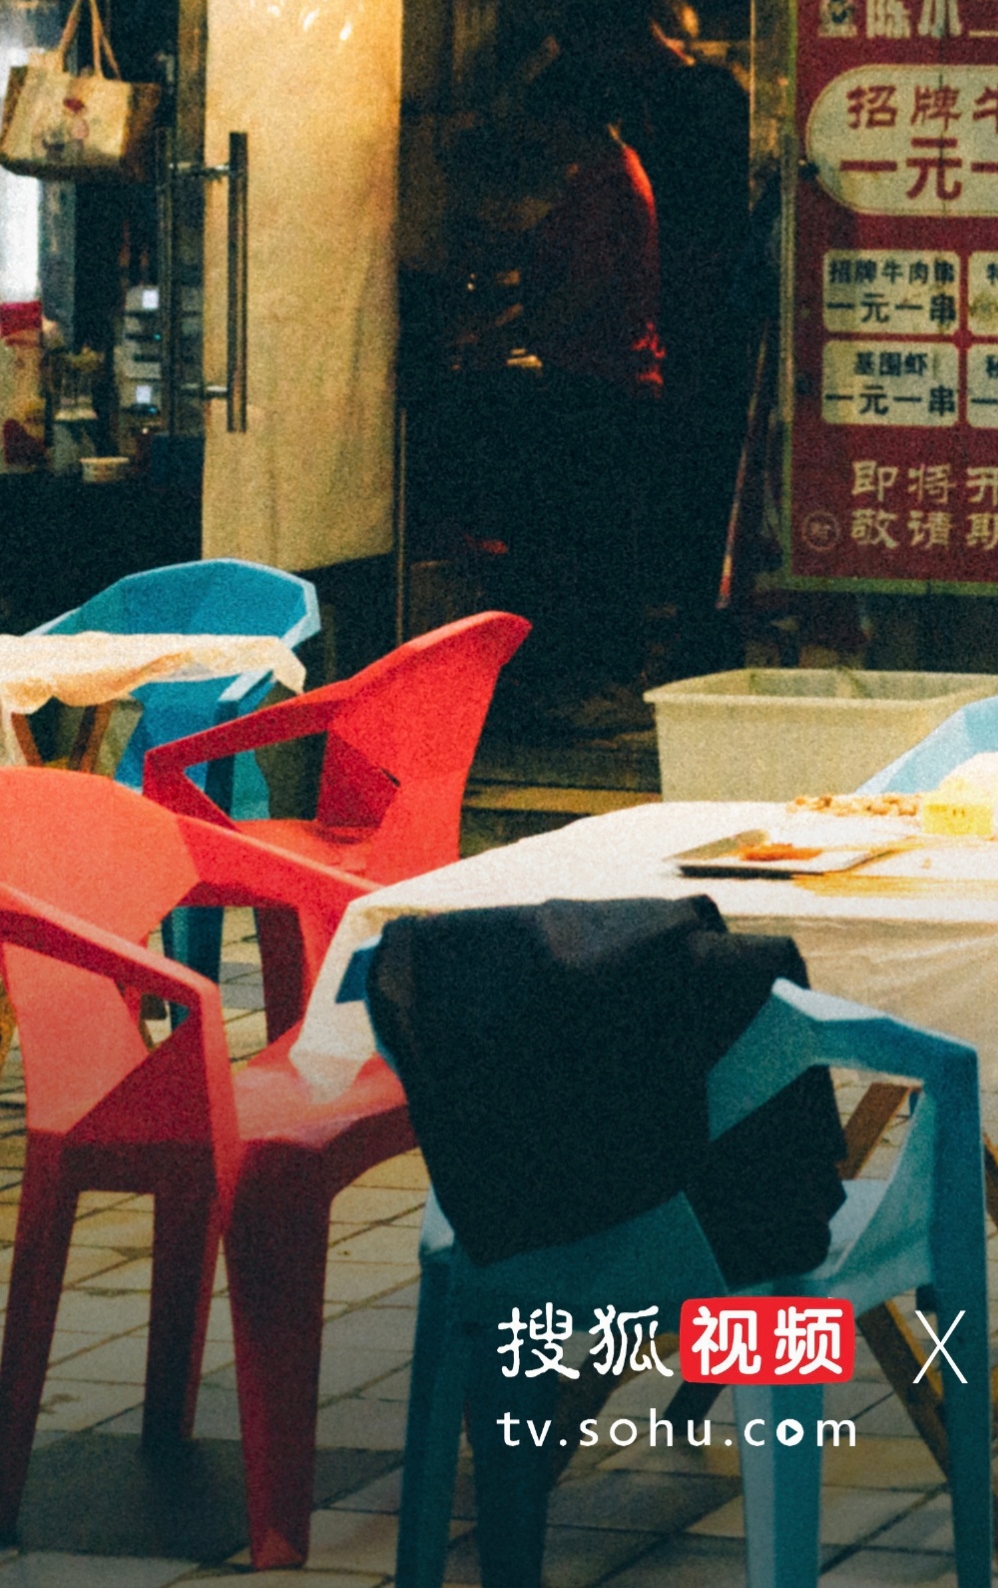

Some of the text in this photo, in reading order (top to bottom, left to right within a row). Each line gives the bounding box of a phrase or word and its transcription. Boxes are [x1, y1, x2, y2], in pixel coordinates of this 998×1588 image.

[826, 293, 957, 325] 一元一串
[853, 351, 929, 378] 基围虾
[825, 384, 956, 417] 一元一串
